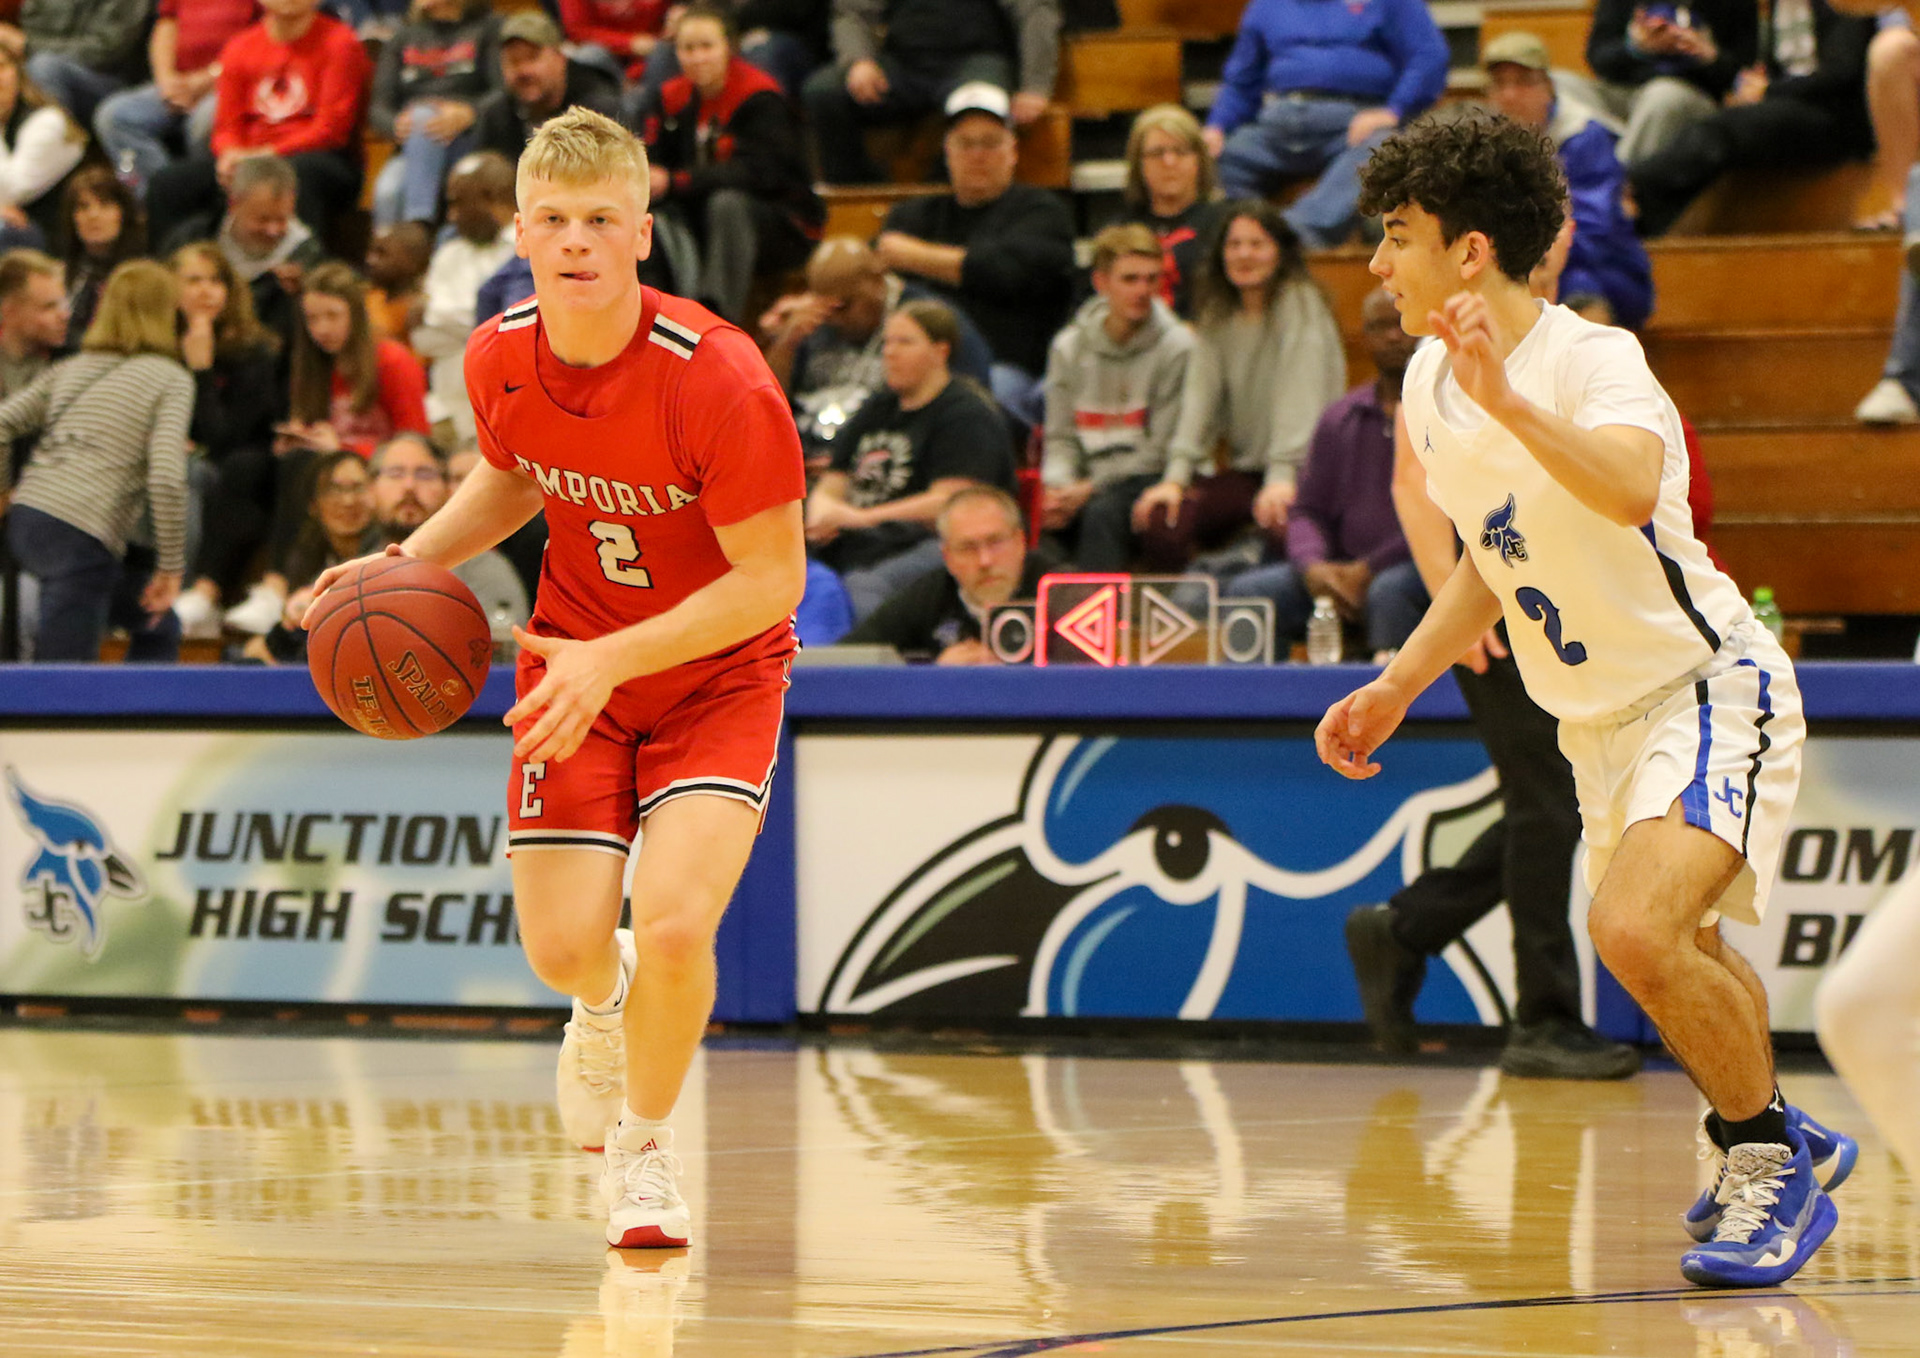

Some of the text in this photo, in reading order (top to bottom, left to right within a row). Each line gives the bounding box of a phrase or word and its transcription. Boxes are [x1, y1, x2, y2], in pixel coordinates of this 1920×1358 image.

[588, 520, 654, 589] 2
[1515, 586, 1588, 666] 2
[519, 761, 547, 818] E
[155, 812, 502, 866] JUNCTION
[1780, 828, 1916, 885] OM
[189, 889, 521, 946] HIGH SCH
